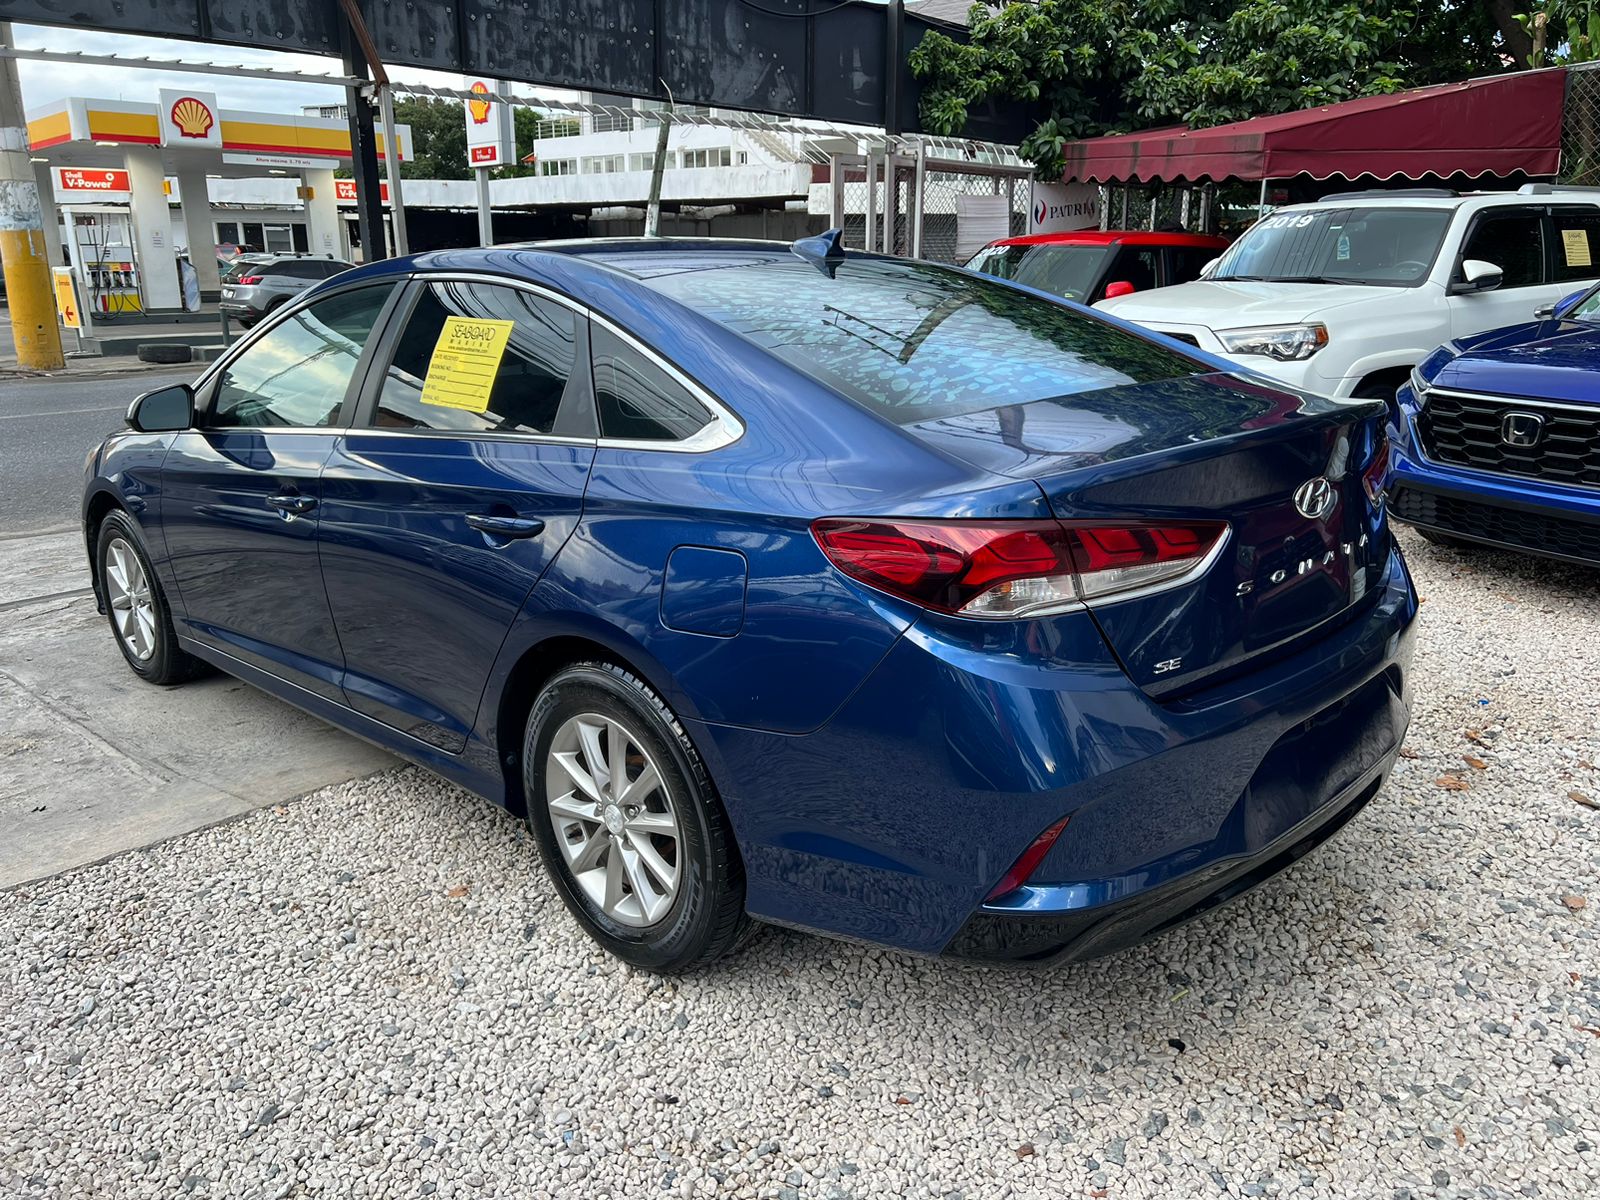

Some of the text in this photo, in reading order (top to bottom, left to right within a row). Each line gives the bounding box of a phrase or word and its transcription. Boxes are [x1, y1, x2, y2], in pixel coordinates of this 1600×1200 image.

[64, 171, 83, 179] Shell
[65, 178, 112, 189] V-Power
[1050, 202, 1095, 219] PATRIA
[1259, 214, 1314, 230] 2019
[451, 324, 496, 341] SEABOARD
[449, 338, 491, 349] MARINE
[1236, 533, 1369, 597] SONATA
[1153, 657, 1182, 674] SE
